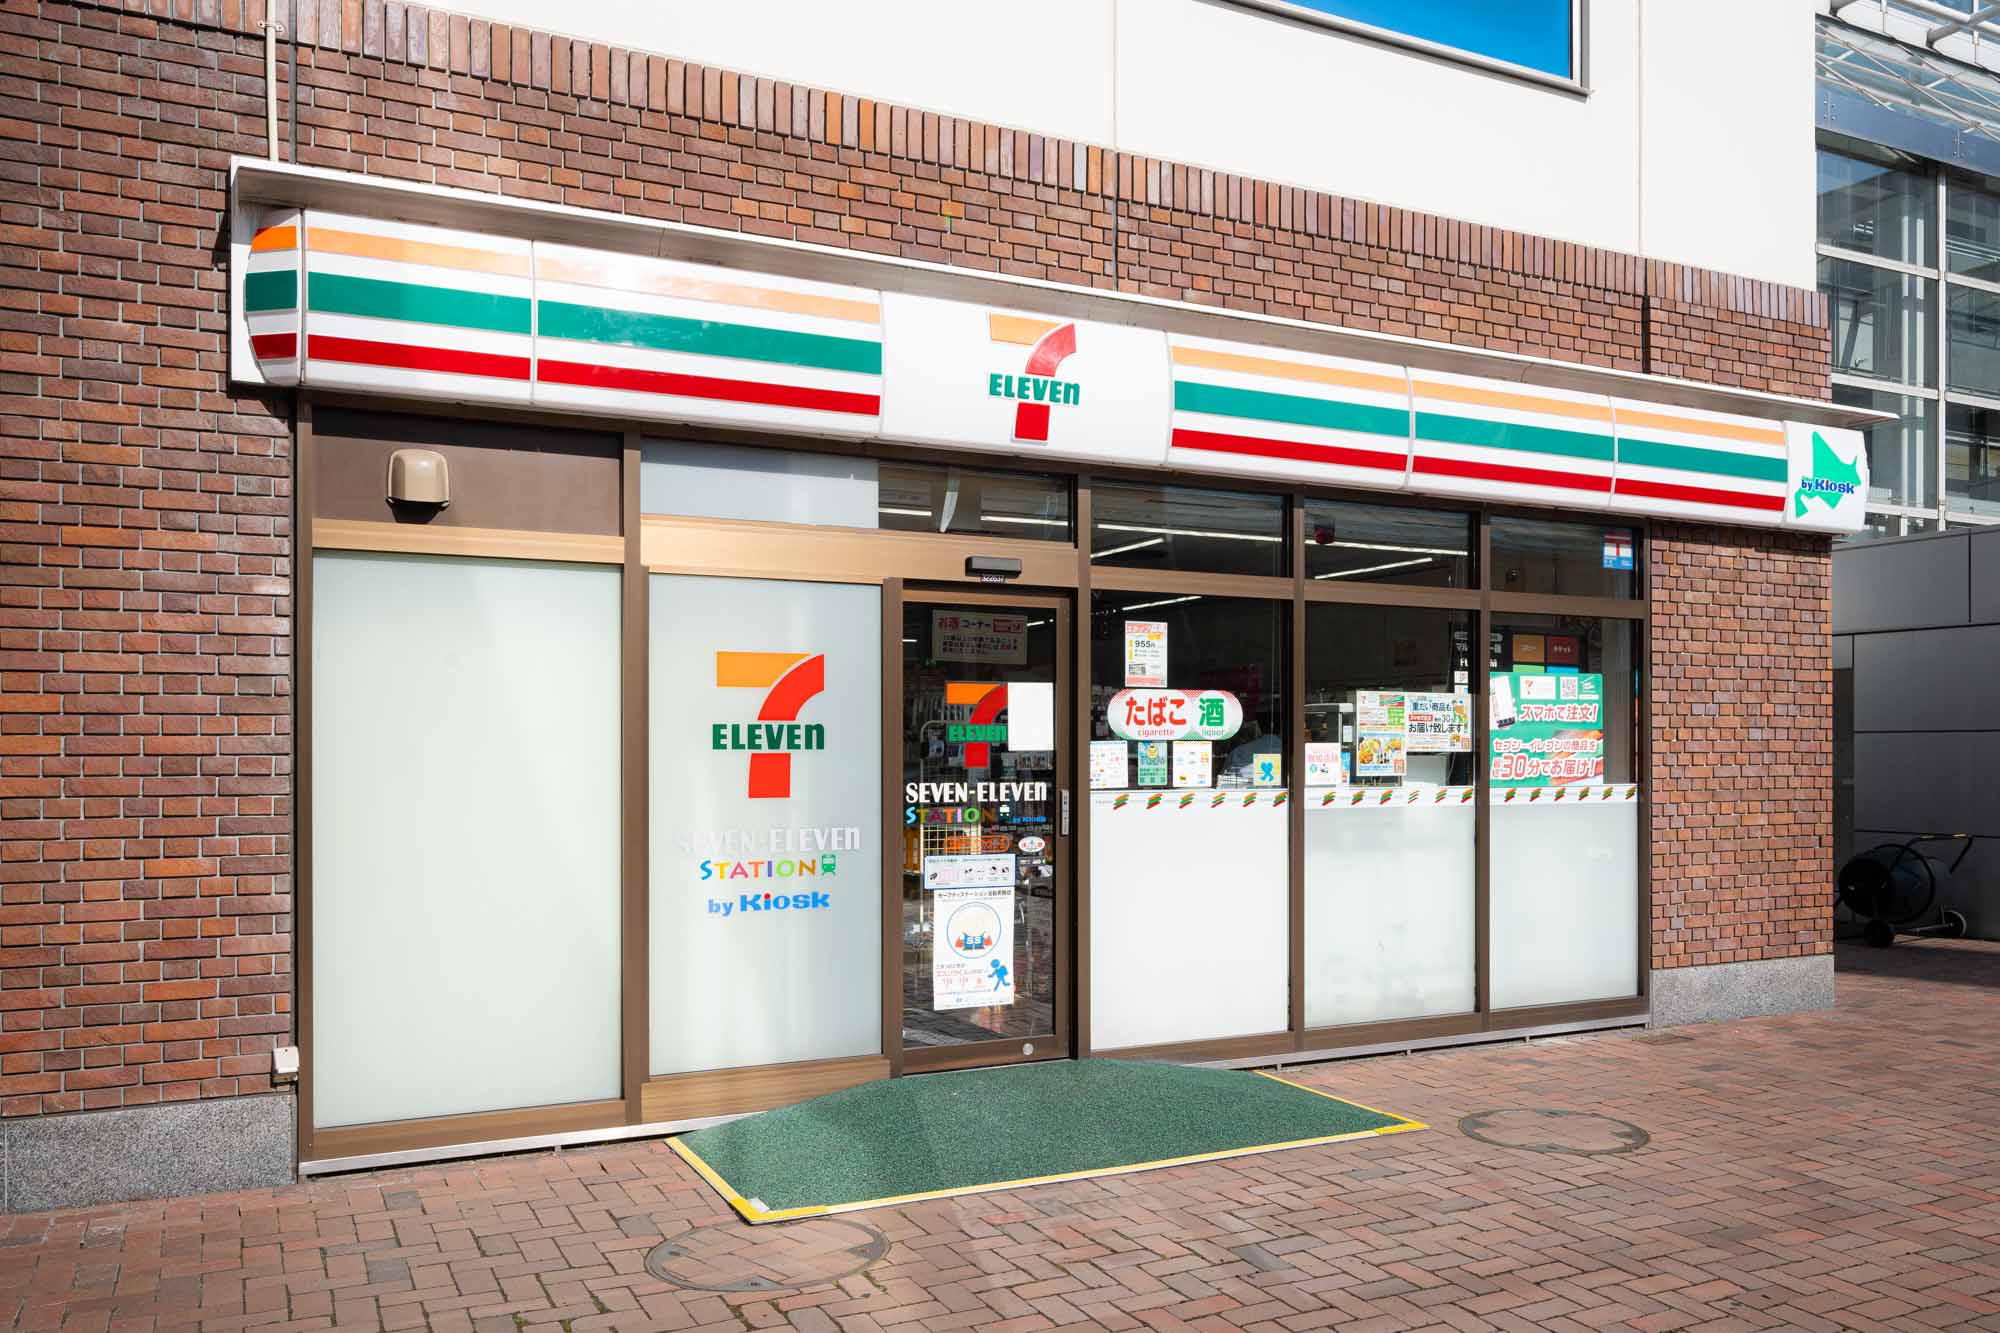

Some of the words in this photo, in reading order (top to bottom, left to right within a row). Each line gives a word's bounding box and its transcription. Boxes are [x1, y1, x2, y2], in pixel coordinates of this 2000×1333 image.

[1801, 479, 1812, 491] by
[1815, 479, 1855, 494] Kiosk
[1125, 696, 1187, 727] たばこ
[1199, 697, 1225, 727] 酒
[1137, 728, 1175, 737] cigarette
[906, 806, 995, 824] STATION
[700, 859, 816, 880] STATION
[708, 899, 733, 916] by
[739, 891, 831, 912] Kiosk
